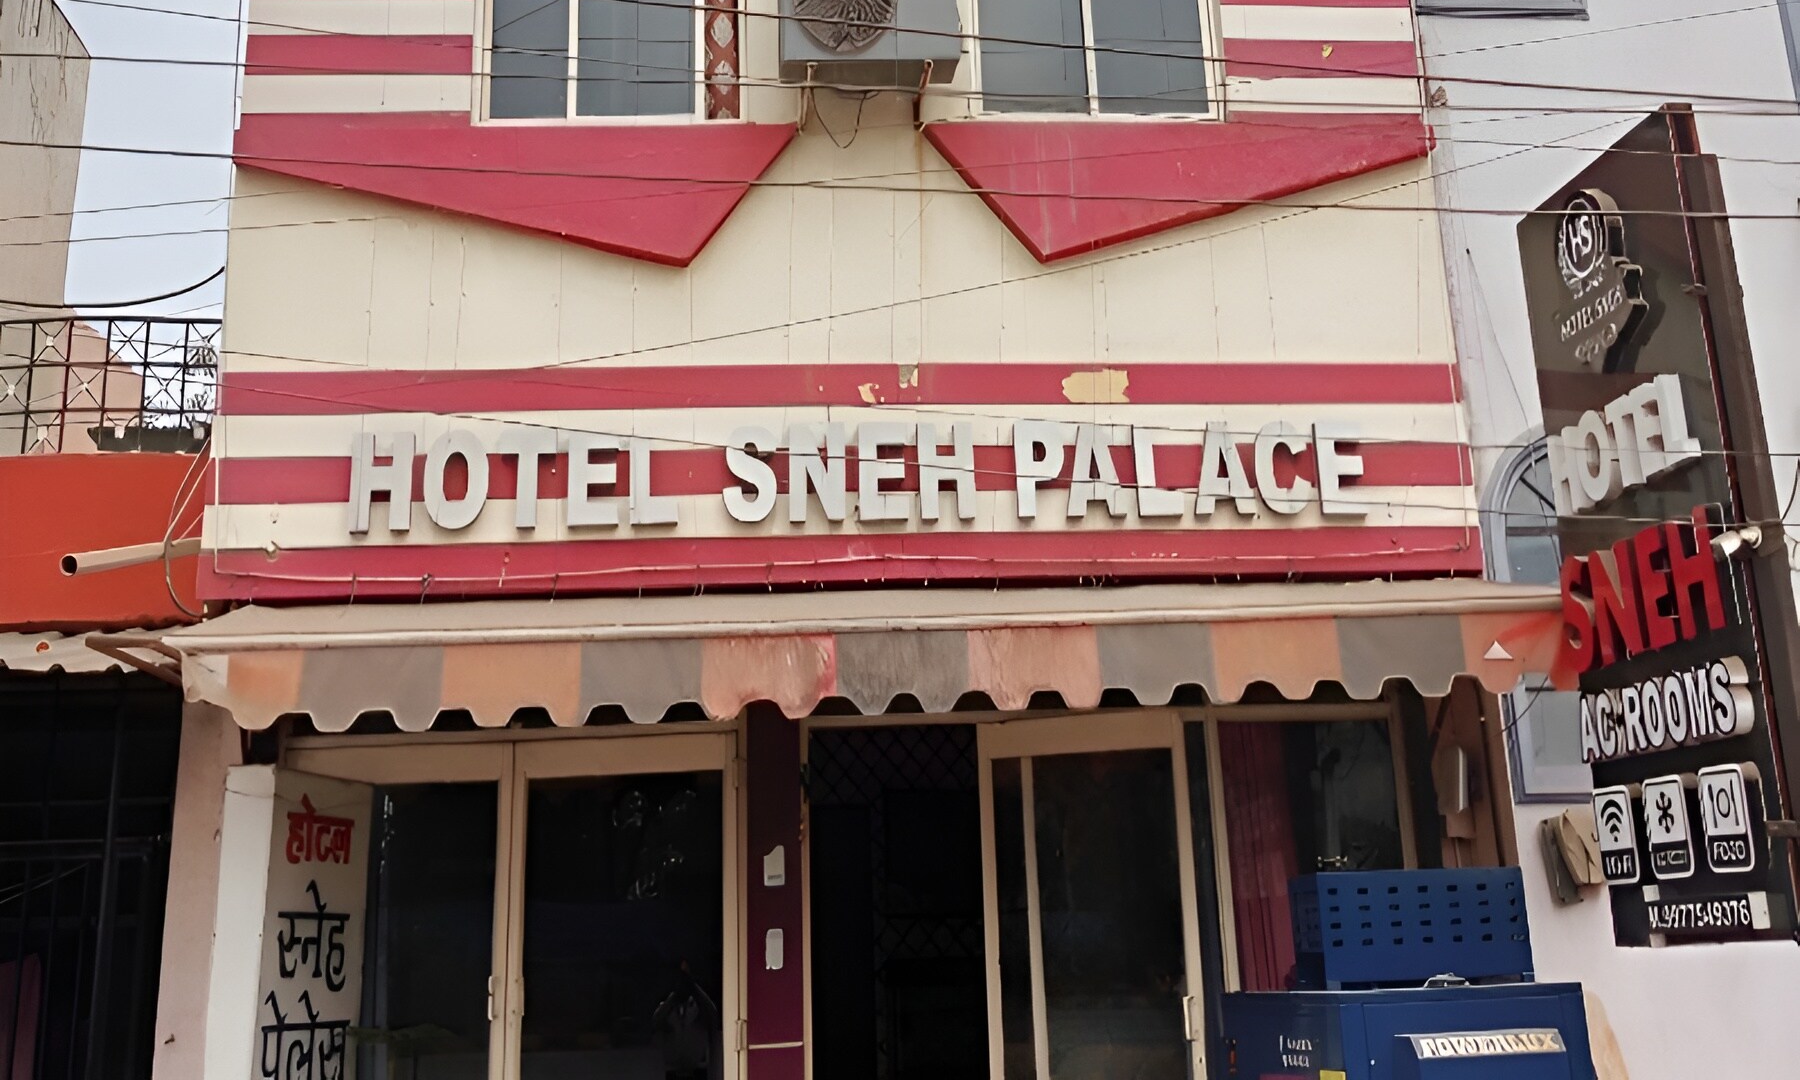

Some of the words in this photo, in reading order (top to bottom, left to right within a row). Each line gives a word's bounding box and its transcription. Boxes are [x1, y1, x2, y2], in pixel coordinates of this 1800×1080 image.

[349, 429, 678, 534] HOTEL
[722, 421, 976, 522] SNEH
[1012, 420, 1367, 519] PALACE
[1547, 373, 1702, 517] HOTEL
[1560, 504, 1727, 674] SNEH
[286, 793, 354, 864] होटल
[277, 879, 350, 992] स्नेह
